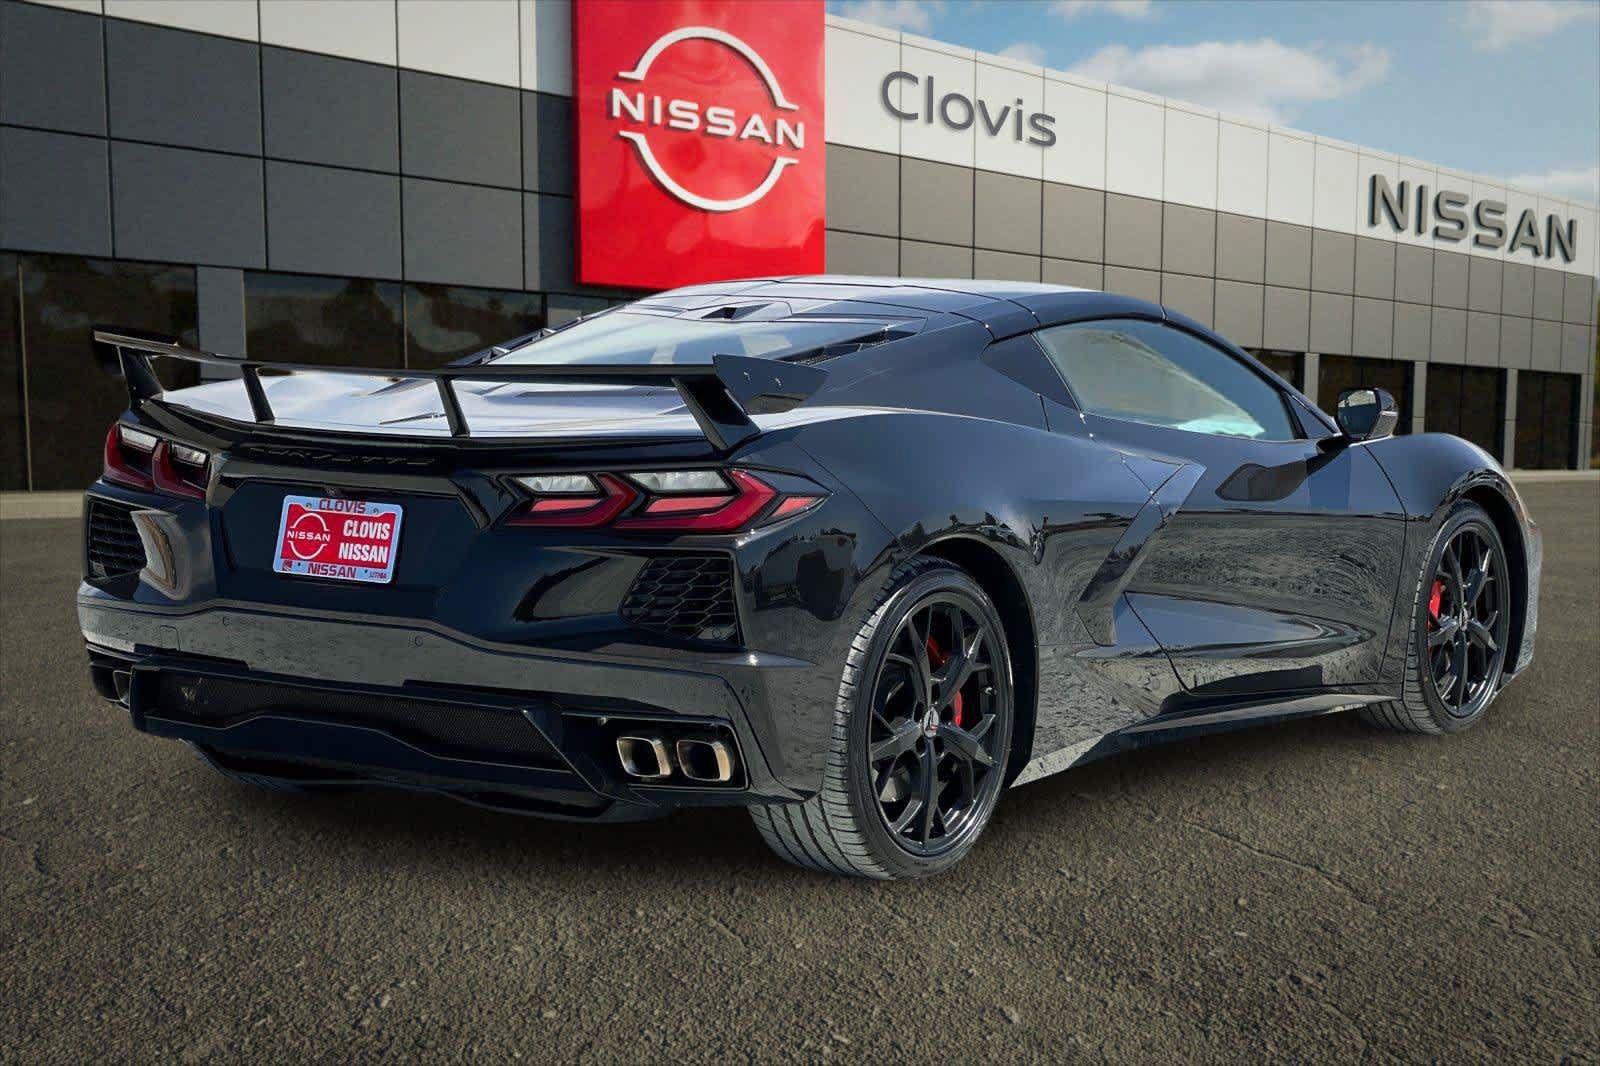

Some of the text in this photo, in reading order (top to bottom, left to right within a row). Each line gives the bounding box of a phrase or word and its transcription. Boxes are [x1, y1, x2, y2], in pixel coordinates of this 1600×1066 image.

[612, 87, 805, 149] NISSAN
[881, 70, 1057, 147] Clovis
[1368, 173, 1577, 263] NISSAN
[319, 499, 367, 514] CLOVIS
[287, 530, 331, 543] NISSAN
[343, 519, 391, 540] CLOVIS
[338, 543, 389, 564] NISSAN
[307, 563, 357, 579] NISSAN
